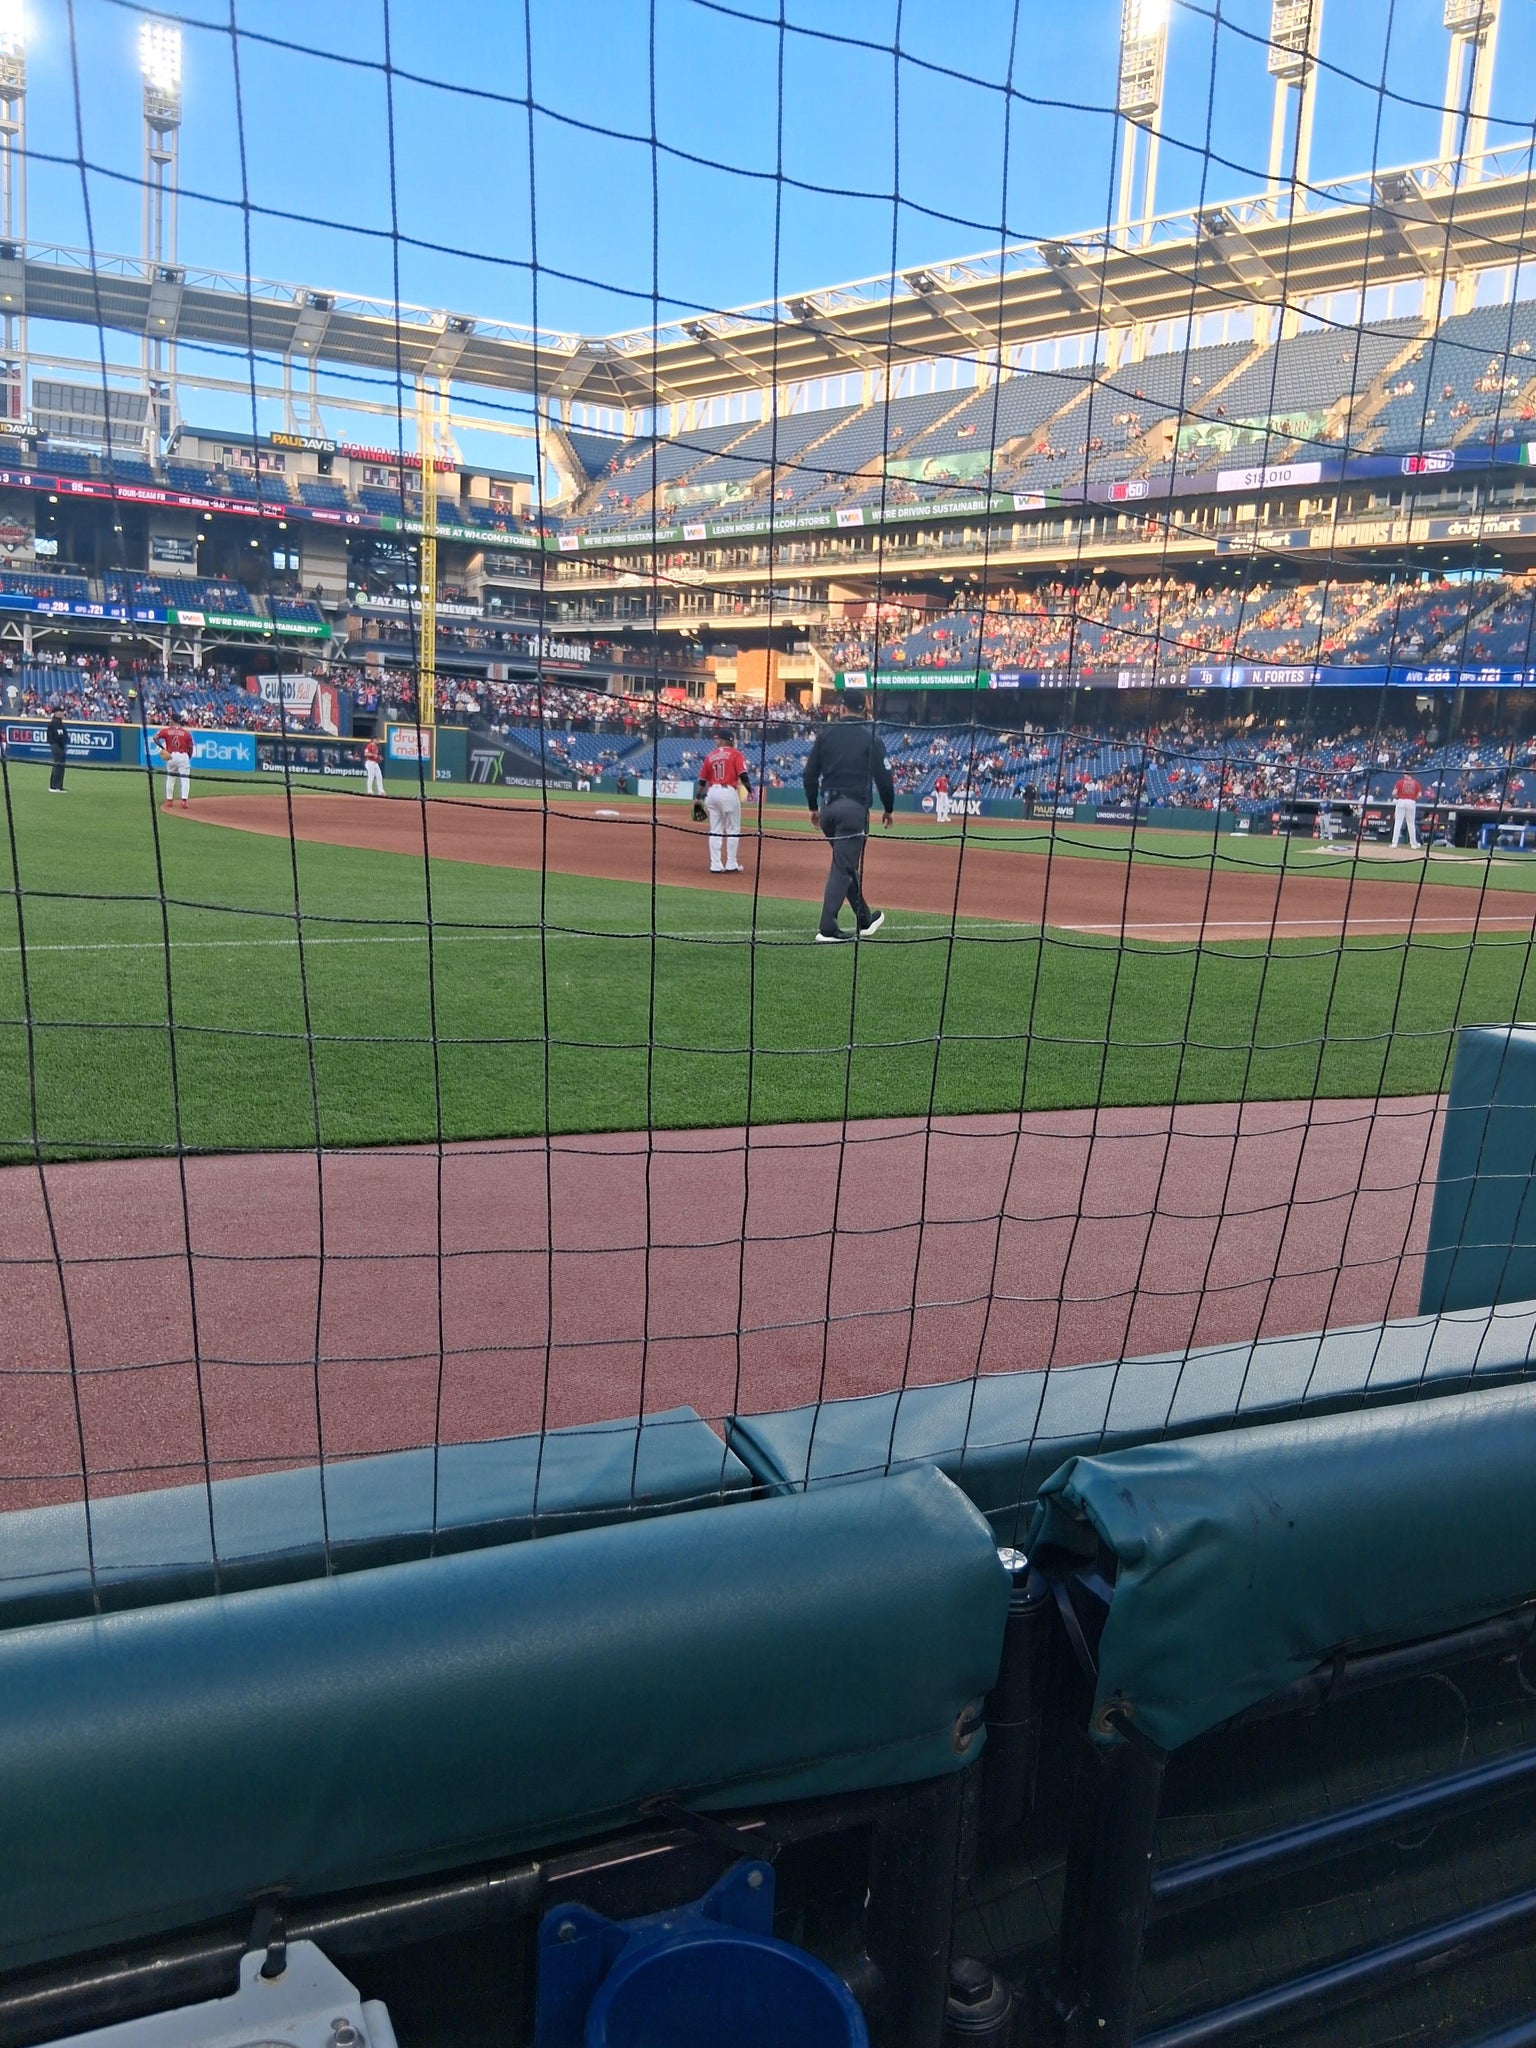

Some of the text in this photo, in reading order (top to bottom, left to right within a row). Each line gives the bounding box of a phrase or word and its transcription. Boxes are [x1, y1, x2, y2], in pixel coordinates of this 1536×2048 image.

[341, 442, 456, 471] PENNANT DISICT
[898, 504, 931, 517] DRIVING
[452, 529, 462, 537] AT
[712, 524, 735, 535] LEARN
[735, 523, 755, 533] MORE
[755, 521, 765, 531] AT
[1391, 520, 1430, 542] CLUB
[1448, 518, 1521, 538] drug mart
[627, 531, 674, 542] SUSTAINBILITY
[436, 603, 484, 616] BREWERY
[208, 616, 319, 635] WE'RE DRIVING SUTAINABILITY
[549, 643, 591, 661] CORNER
[892, 675, 920, 685] DRIVING
[921, 674, 976, 685] SUSTAINABILITY
[1253, 670, 1263, 683] N.
[1265, 670, 1304, 683] FORTES
[1406, 672, 1423, 682] AVG
[435, 770, 451, 779] 325
[712, 760, 726, 780] 11
